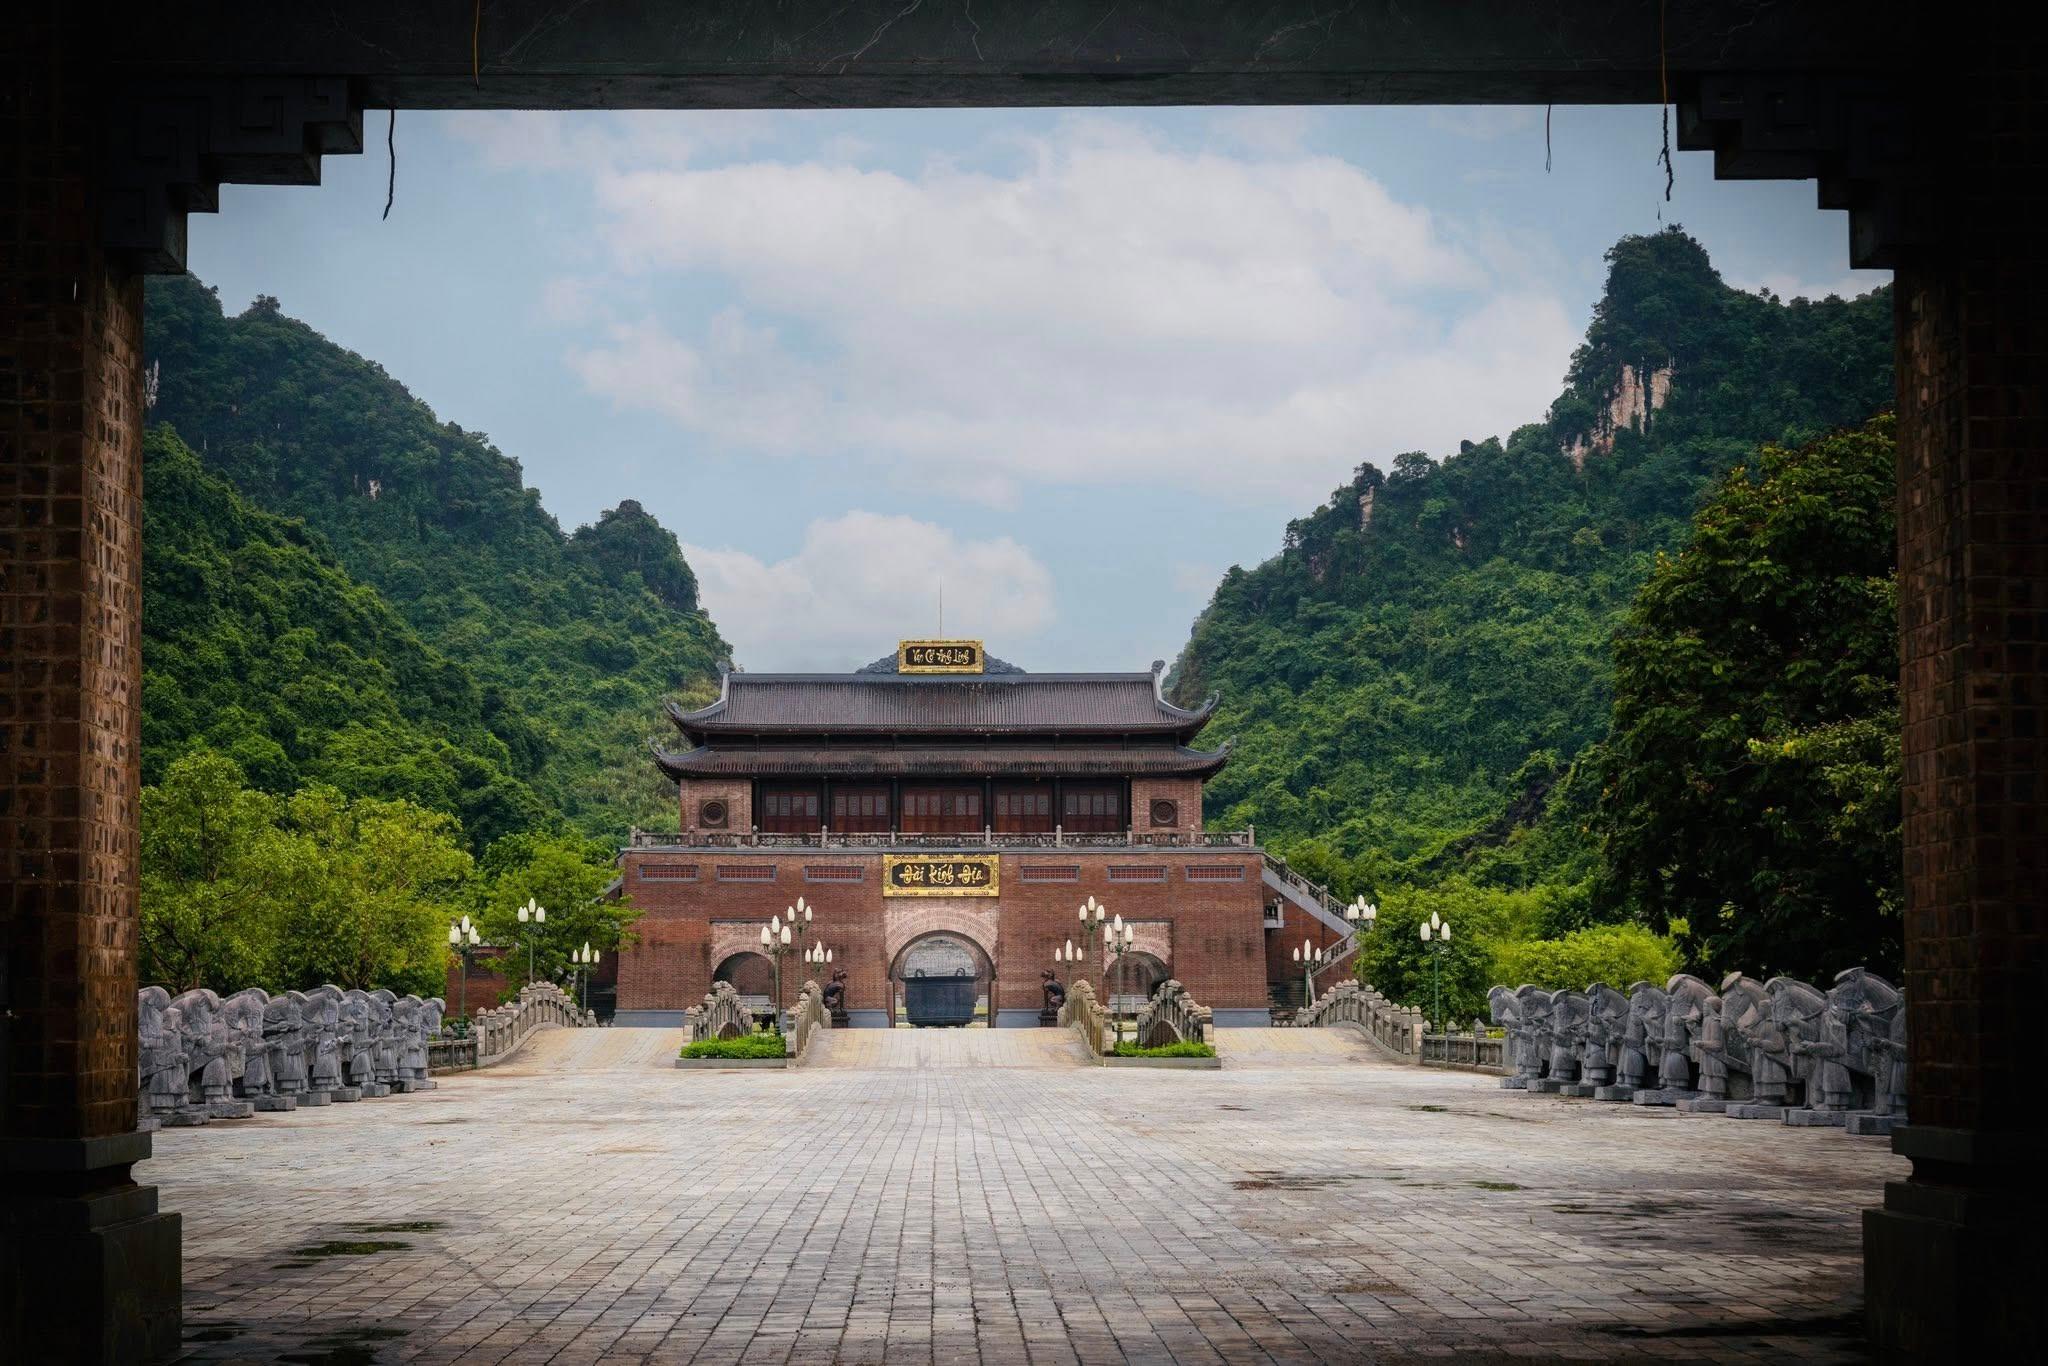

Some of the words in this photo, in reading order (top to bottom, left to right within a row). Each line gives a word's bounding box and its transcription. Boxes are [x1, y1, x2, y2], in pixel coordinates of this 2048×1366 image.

[953, 649, 970, 664] Linh
[899, 865, 925, 884] Đài
[958, 865, 984, 884] Địa
